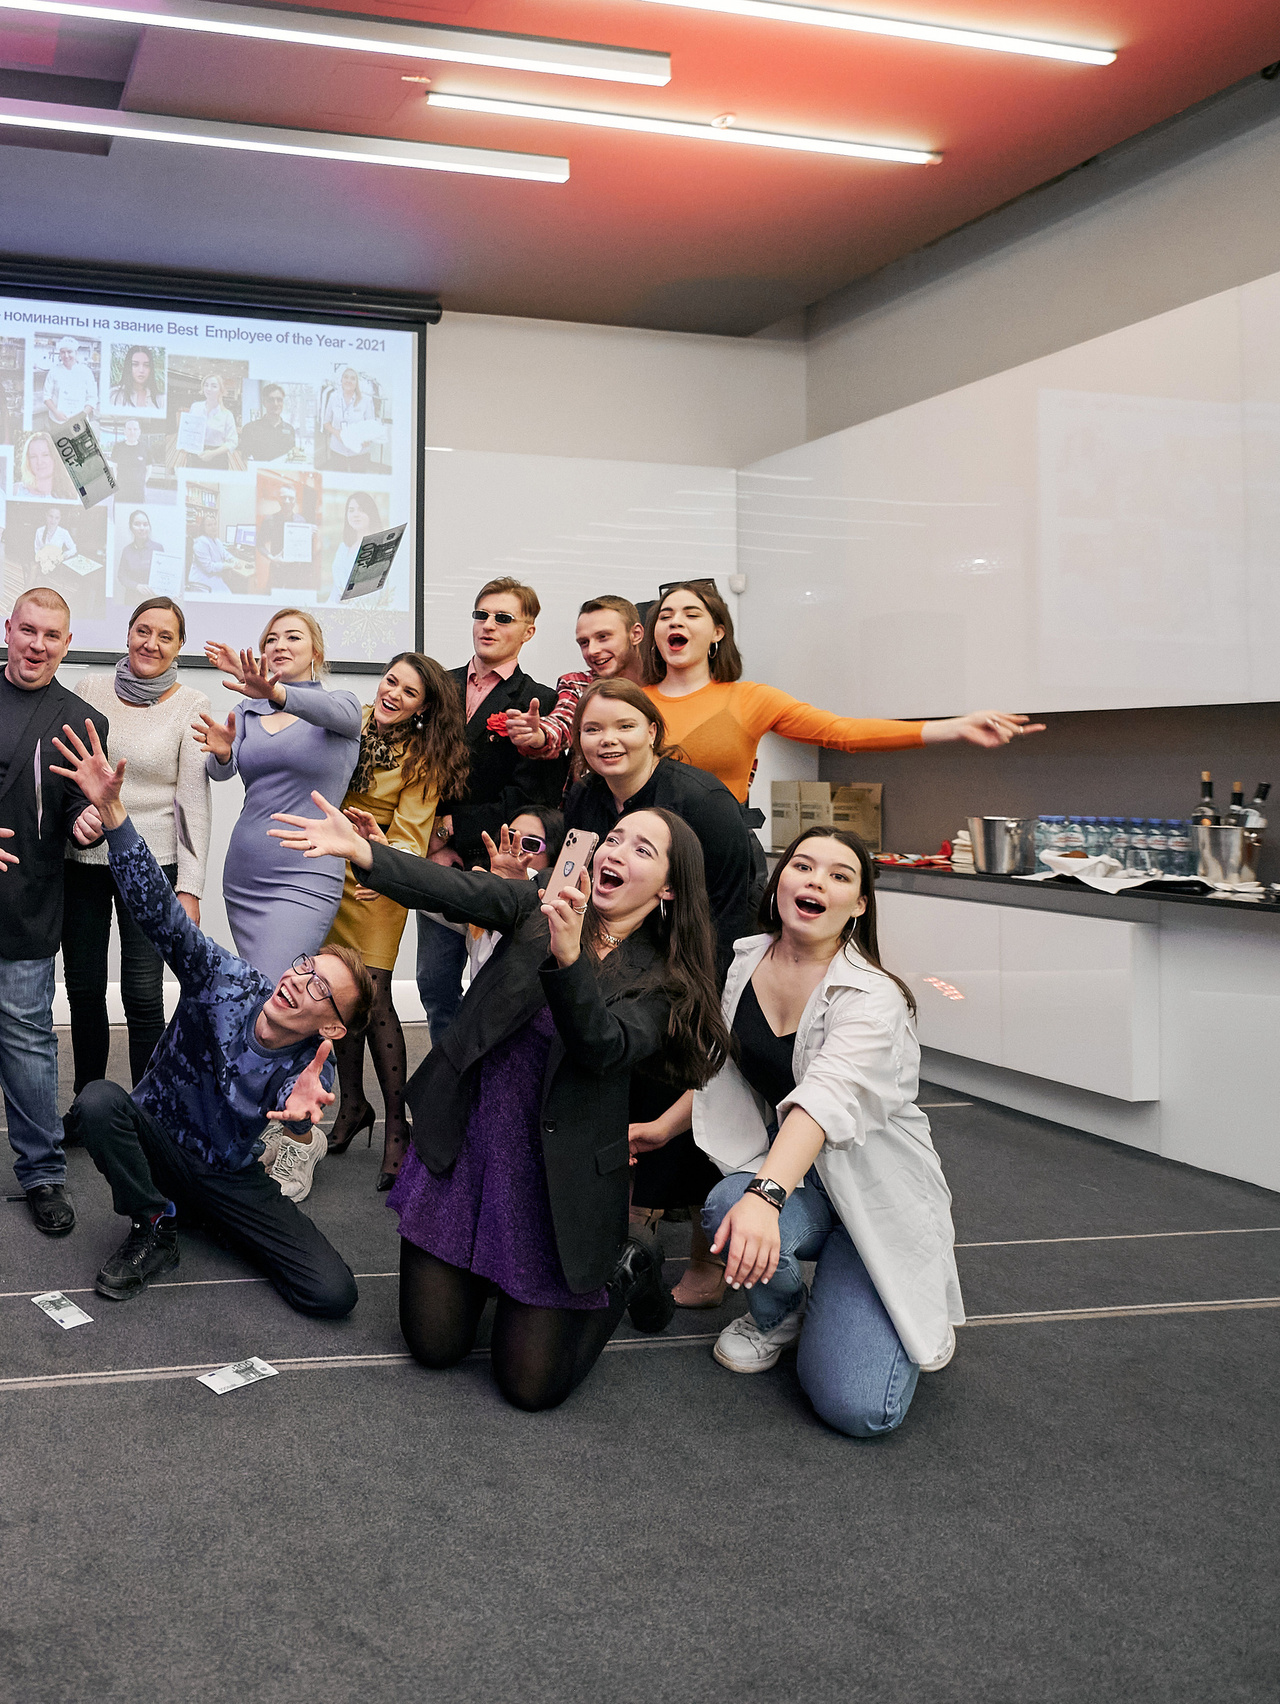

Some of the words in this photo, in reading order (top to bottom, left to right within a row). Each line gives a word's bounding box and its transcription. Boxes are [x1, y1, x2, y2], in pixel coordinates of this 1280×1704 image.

[4, 311, 89, 328] номинанты
[93, 319, 110, 329] на
[113, 321, 164, 334] звание
[167, 322, 199, 337] Best
[205, 325, 273, 344] Employee
[276, 330, 290, 344] of
[292, 331, 313, 346] the
[315, 334, 346, 349] Year
[355, 338, 386, 352] 2021
[57, 437, 76, 464] 100
